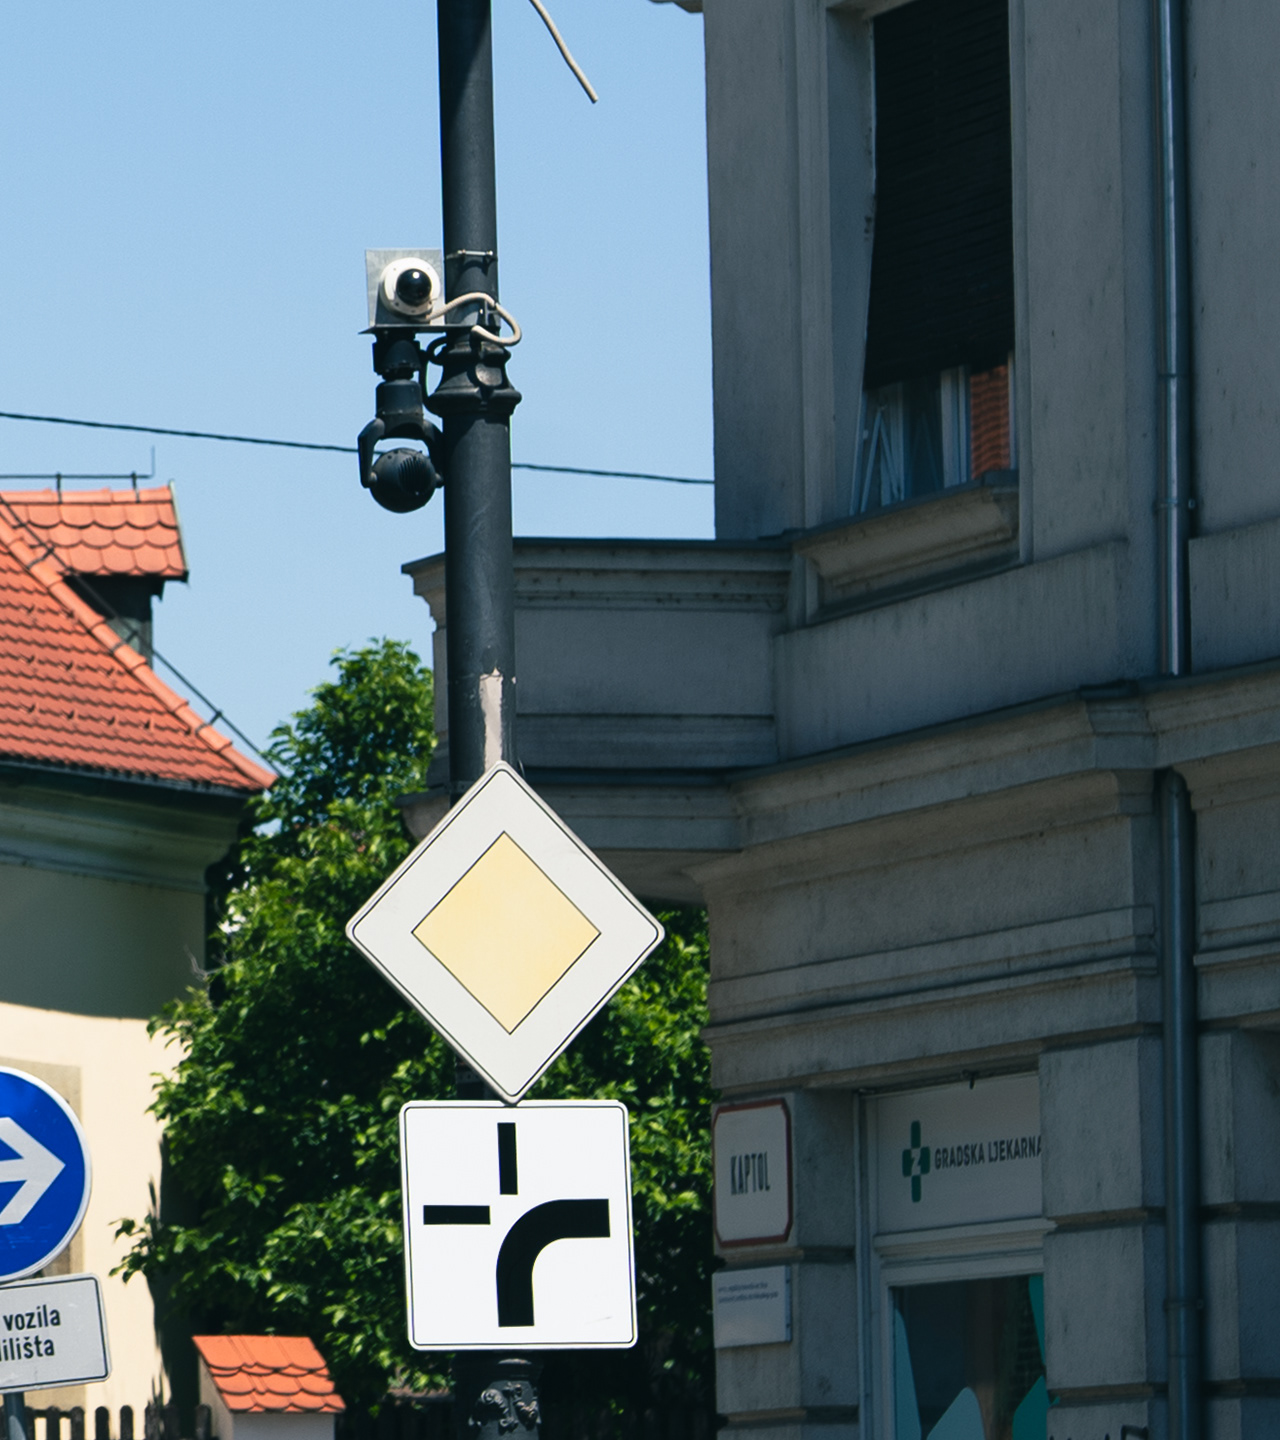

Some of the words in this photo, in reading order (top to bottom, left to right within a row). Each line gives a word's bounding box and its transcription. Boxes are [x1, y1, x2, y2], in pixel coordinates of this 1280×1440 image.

[934, 1141, 986, 1170] GRADSKA
[987, 1134, 1042, 1164] LJEKARNA
[730, 1150, 771, 1196] KAPTOL
[2, 1304, 62, 1333] vozila
